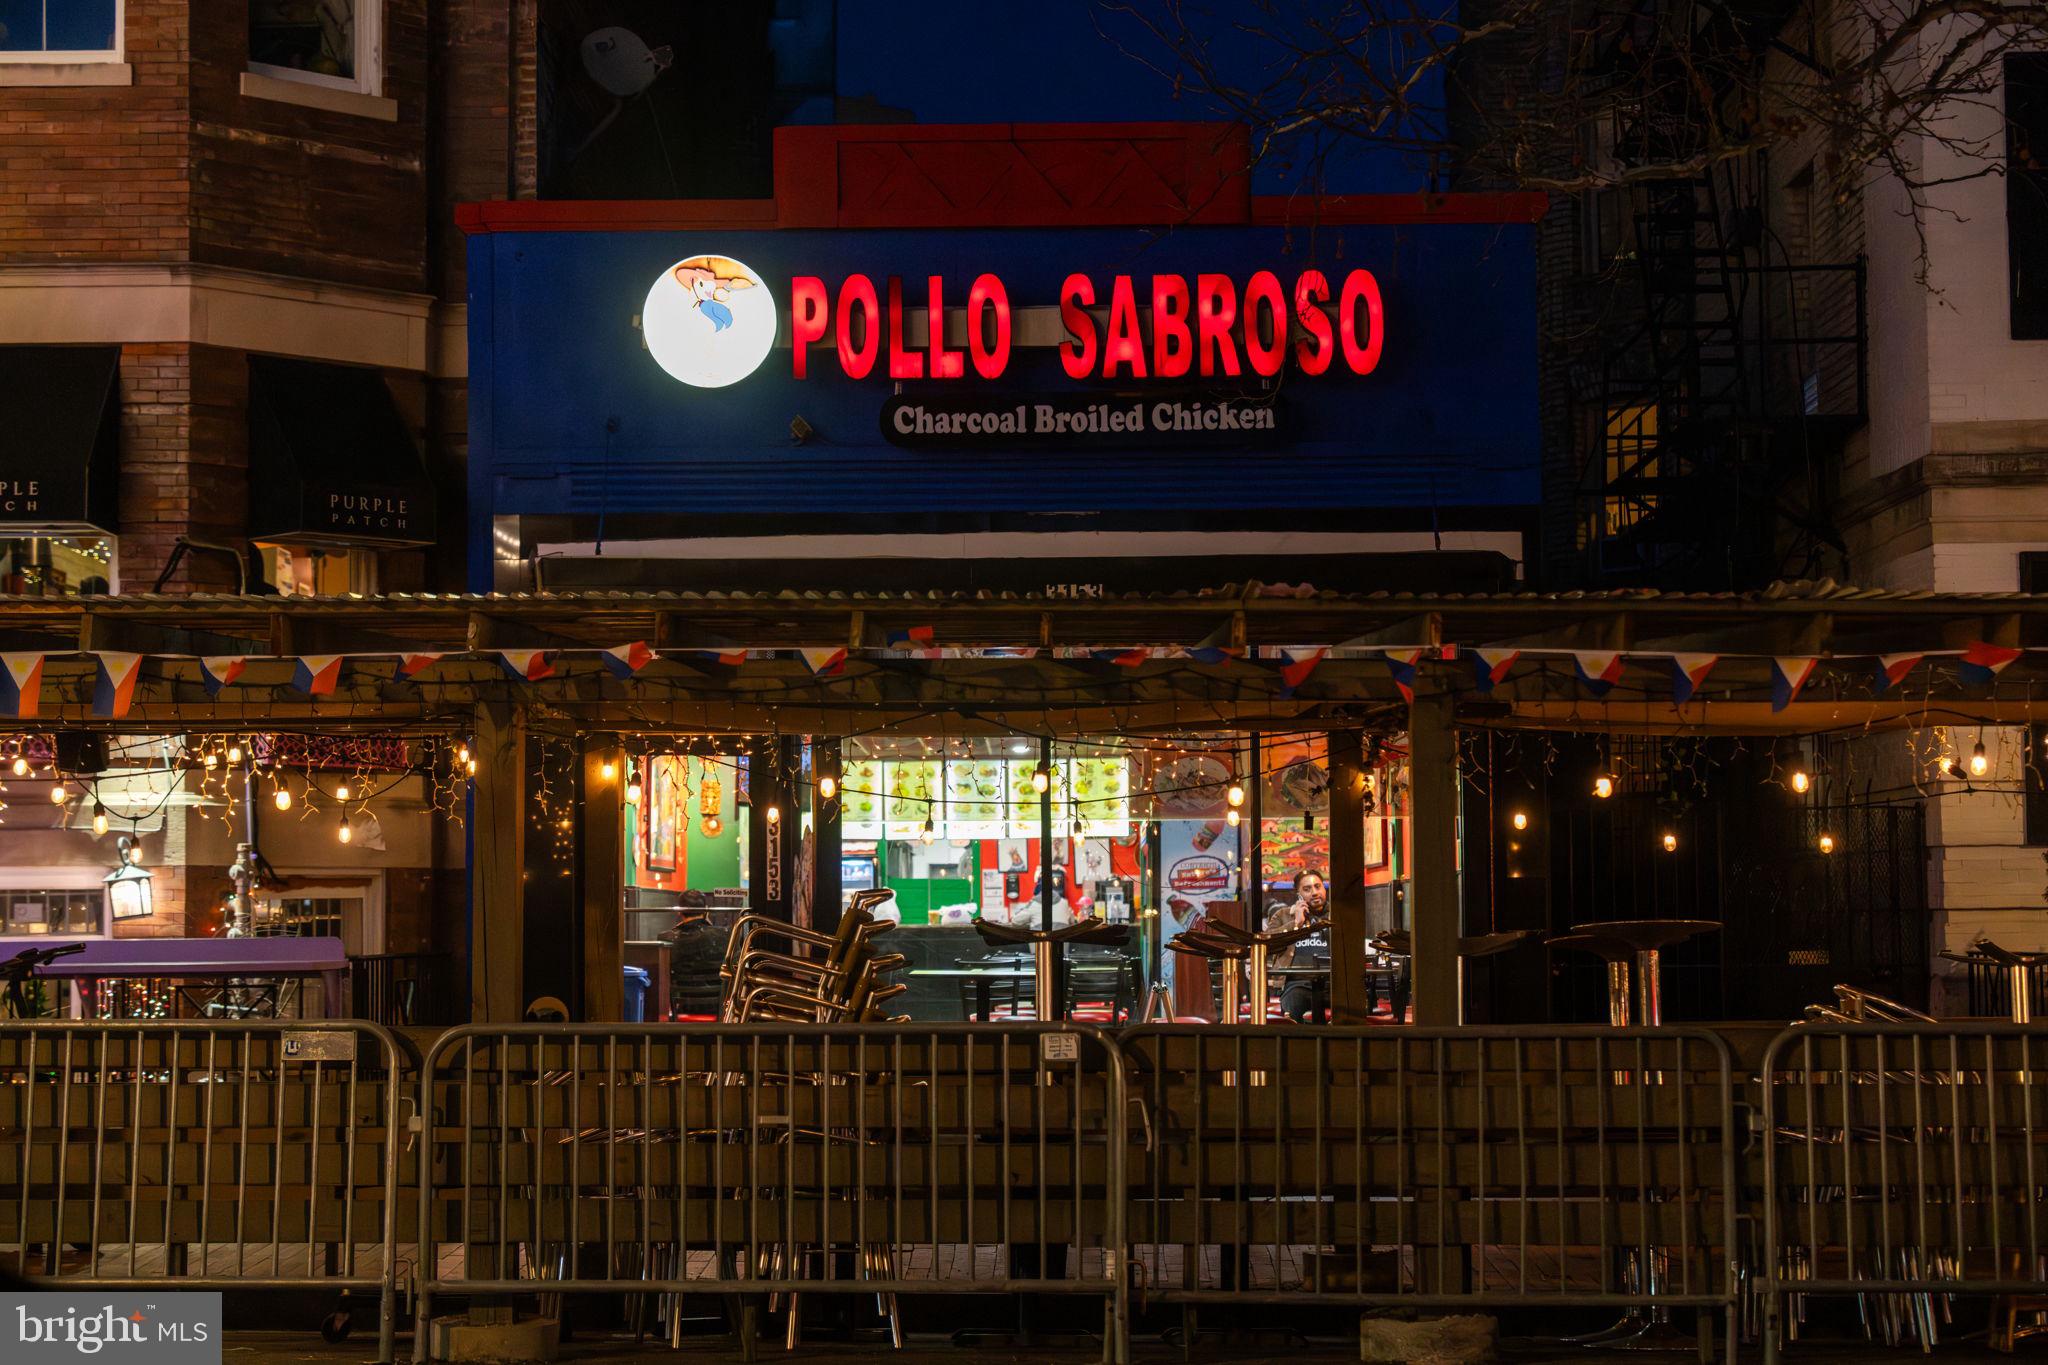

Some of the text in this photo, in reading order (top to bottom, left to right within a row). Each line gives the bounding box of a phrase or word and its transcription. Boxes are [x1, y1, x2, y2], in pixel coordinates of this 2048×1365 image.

[791, 269, 1385, 380] POLLO SABROSO
[893, 402, 1275, 434] Charcoal Broiled Chicken
[330, 494, 408, 514] PURPLE
[331, 513, 406, 529] PATCH
